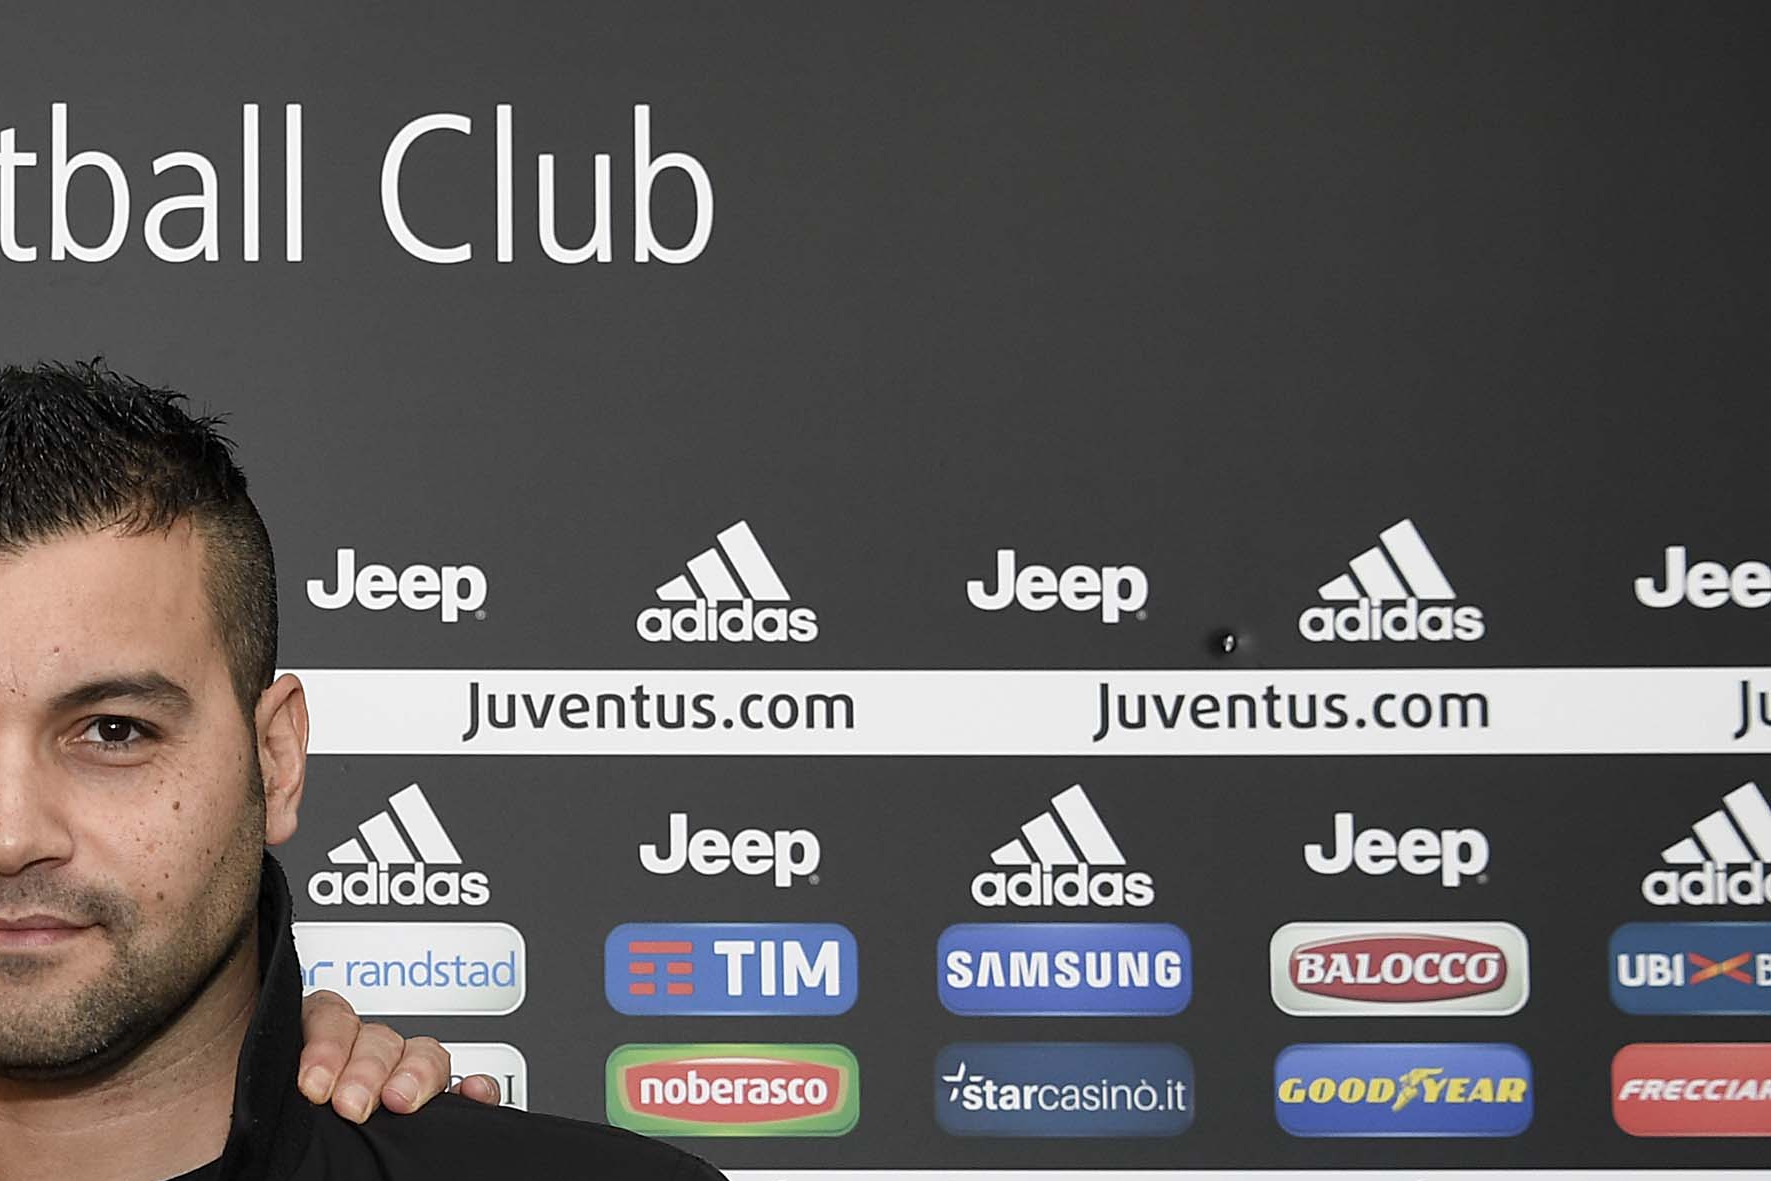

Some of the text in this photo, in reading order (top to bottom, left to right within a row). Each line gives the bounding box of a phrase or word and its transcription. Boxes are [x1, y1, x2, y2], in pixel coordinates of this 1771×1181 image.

[382, 104, 713, 263] Club
[306, 549, 486, 622] Jeep
[966, 549, 1148, 622] Jeep
[1635, 546, 1771, 608] Jee
[636, 598, 819, 642] adidas
[1298, 600, 1485, 642] adidas
[462, 682, 855, 742] Juventus.com
[1092, 683, 1489, 742] Juventus.com
[639, 813, 820, 888] Jeep
[1304, 812, 1489, 887] Jeep
[307, 862, 490, 906] adidas
[971, 864, 1155, 907] adidas
[1641, 864, 1771, 906] adid
[346, 951, 516, 987] randstad
[713, 940, 841, 996] TIM
[946, 949, 1183, 989] SAMSUNG
[1297, 952, 1501, 985] BALOCCO
[1617, 953, 1685, 988] UBI
[640, 1070, 828, 1106] noberasco
[962, 1078, 1187, 1111] starcasinò.it
